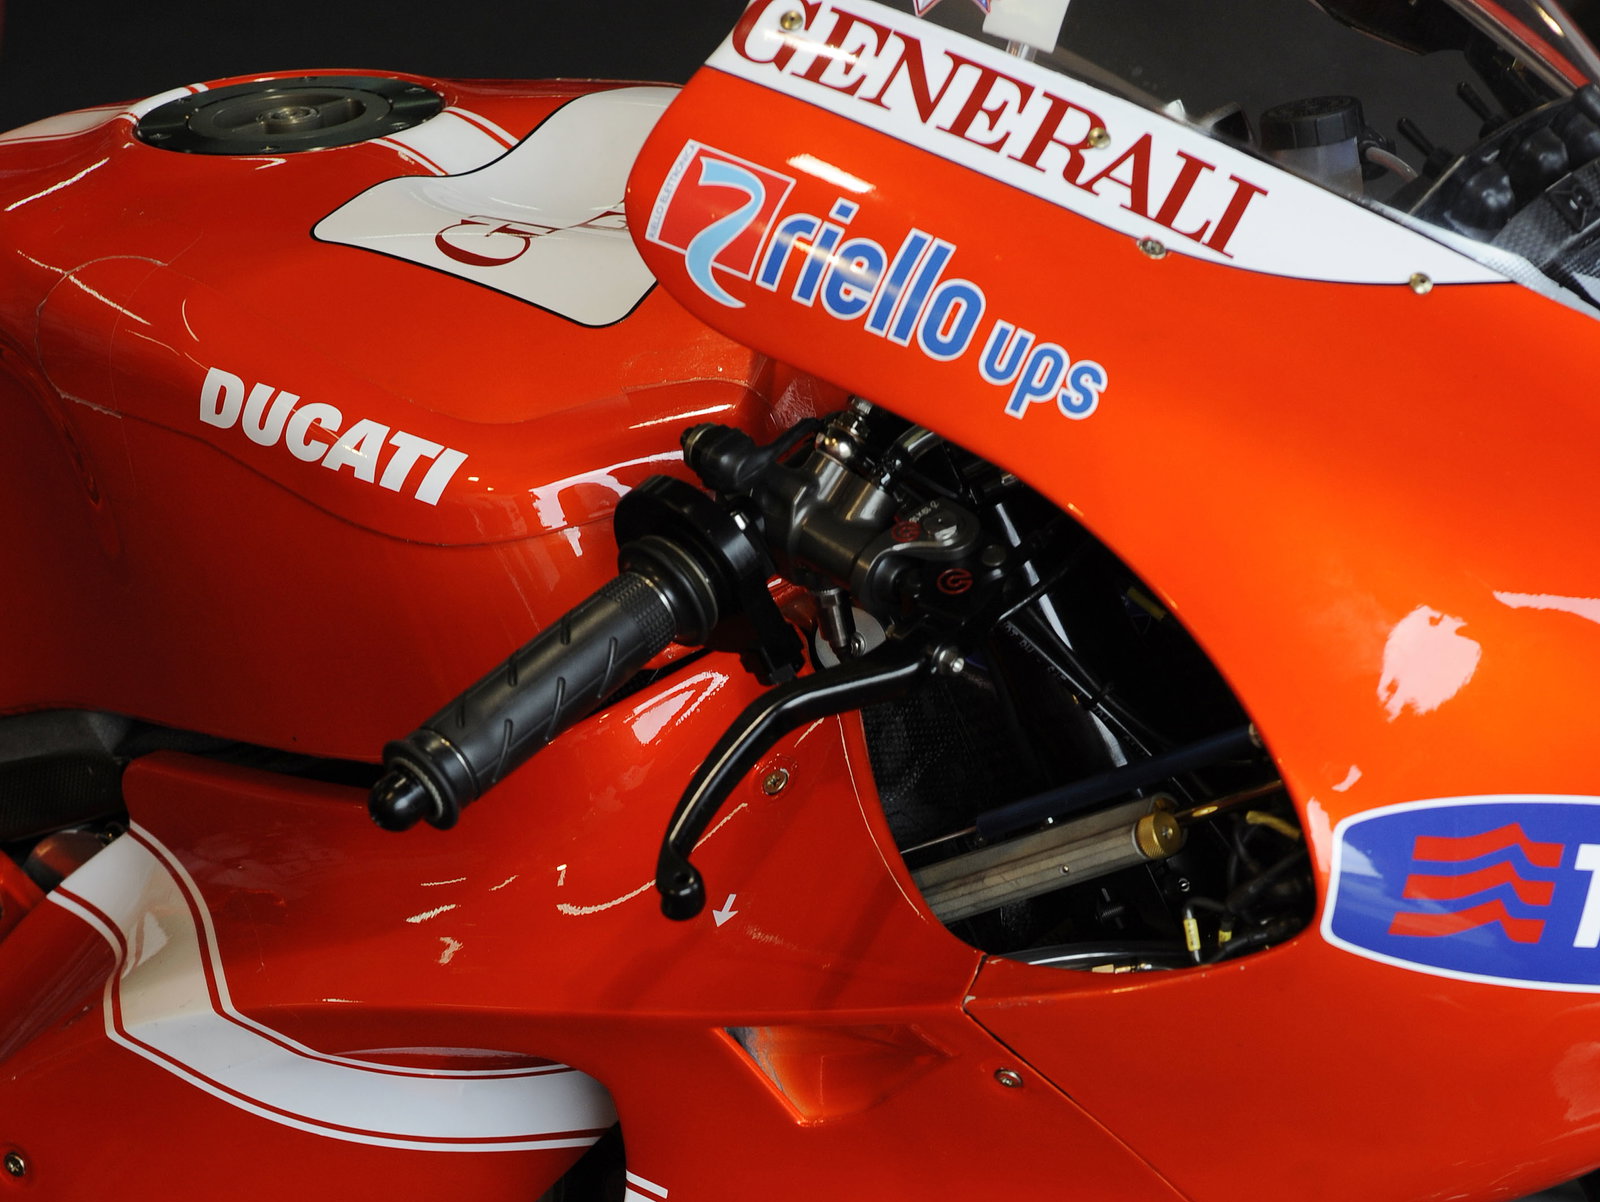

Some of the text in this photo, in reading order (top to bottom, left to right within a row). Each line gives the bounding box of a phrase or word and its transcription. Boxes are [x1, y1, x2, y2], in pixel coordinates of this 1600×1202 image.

[732, 0, 1268, 258] GENERALI
[756, 195, 1108, 420] riello ups
[200, 367, 469, 506] DUCATI
